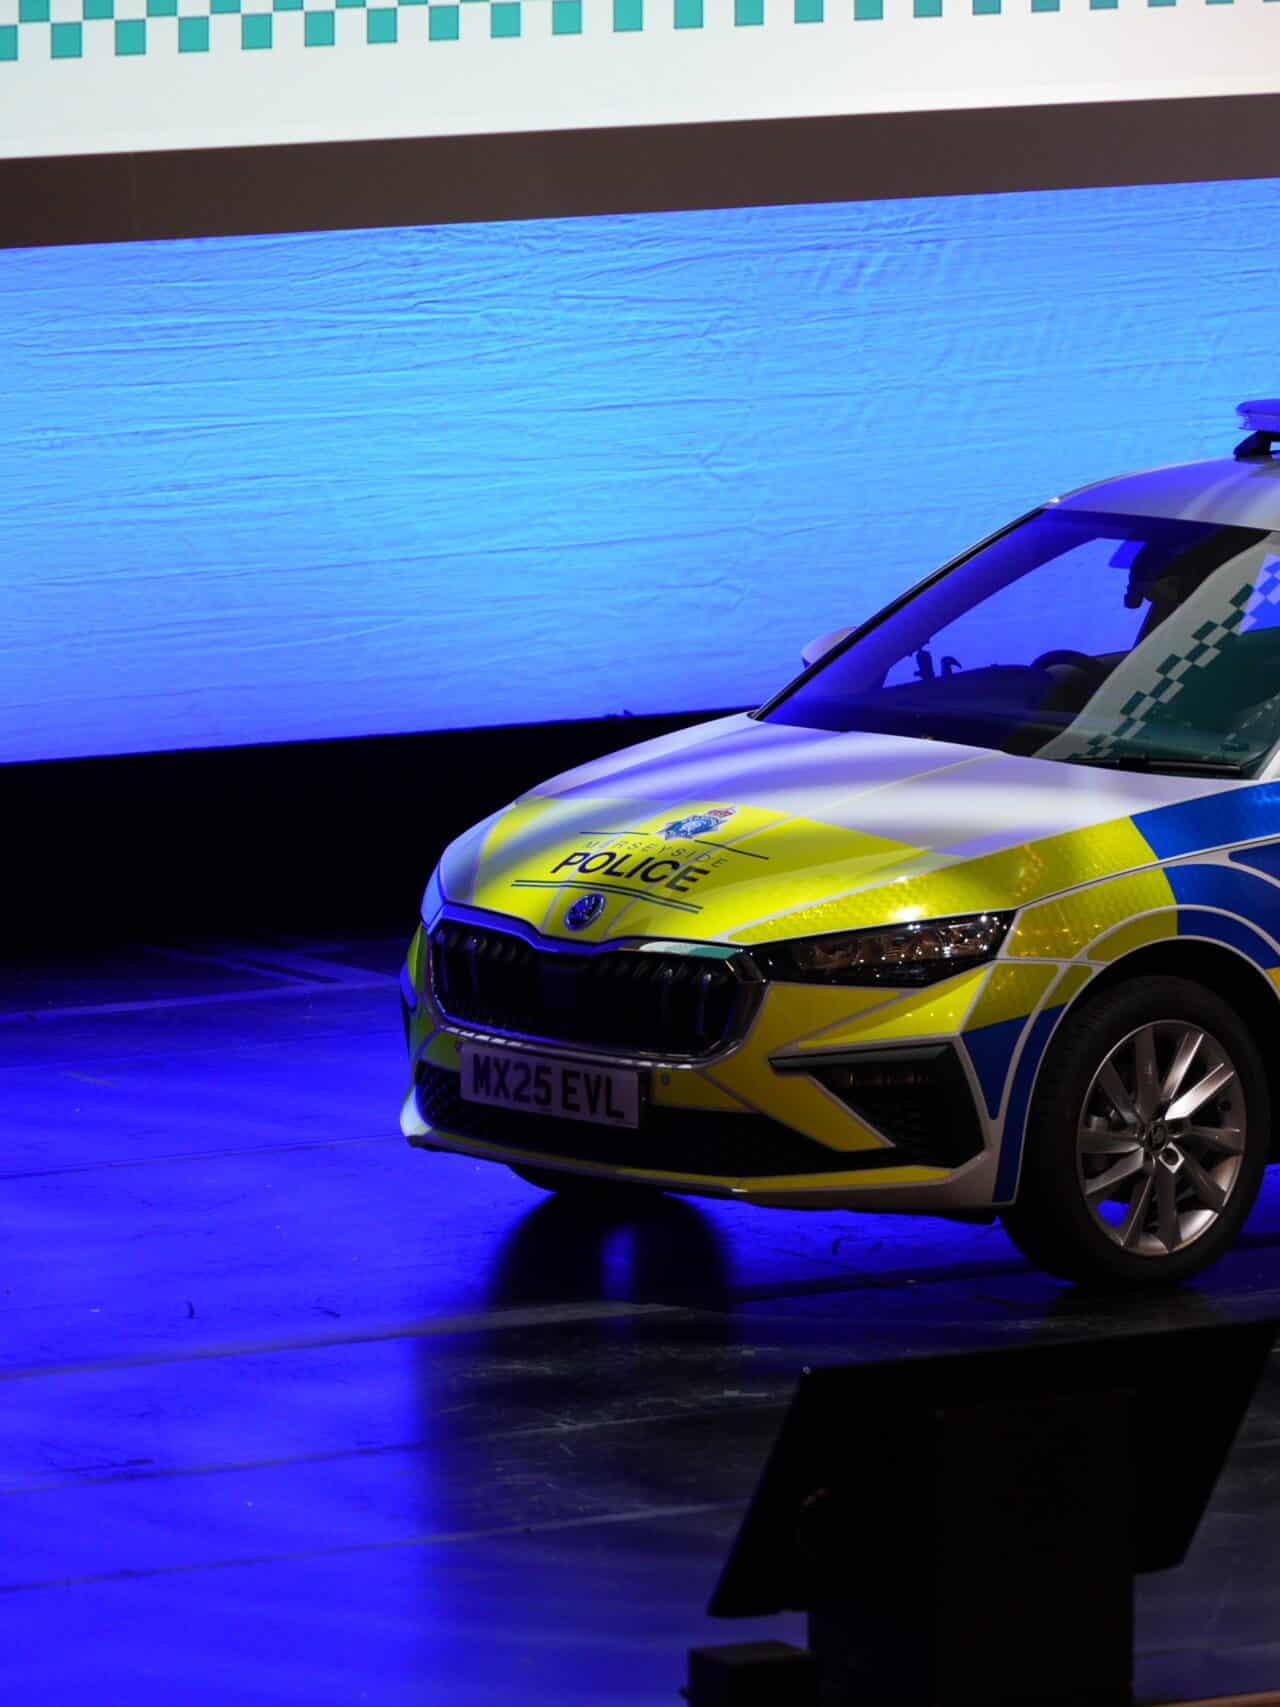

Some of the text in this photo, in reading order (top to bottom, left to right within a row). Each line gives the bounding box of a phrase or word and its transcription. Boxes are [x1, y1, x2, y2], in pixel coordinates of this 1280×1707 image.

[550, 852, 710, 892] POLICE
[583, 839, 729, 868] MRSEYSIDE
[473, 1053, 625, 1119] MX25 EVL
